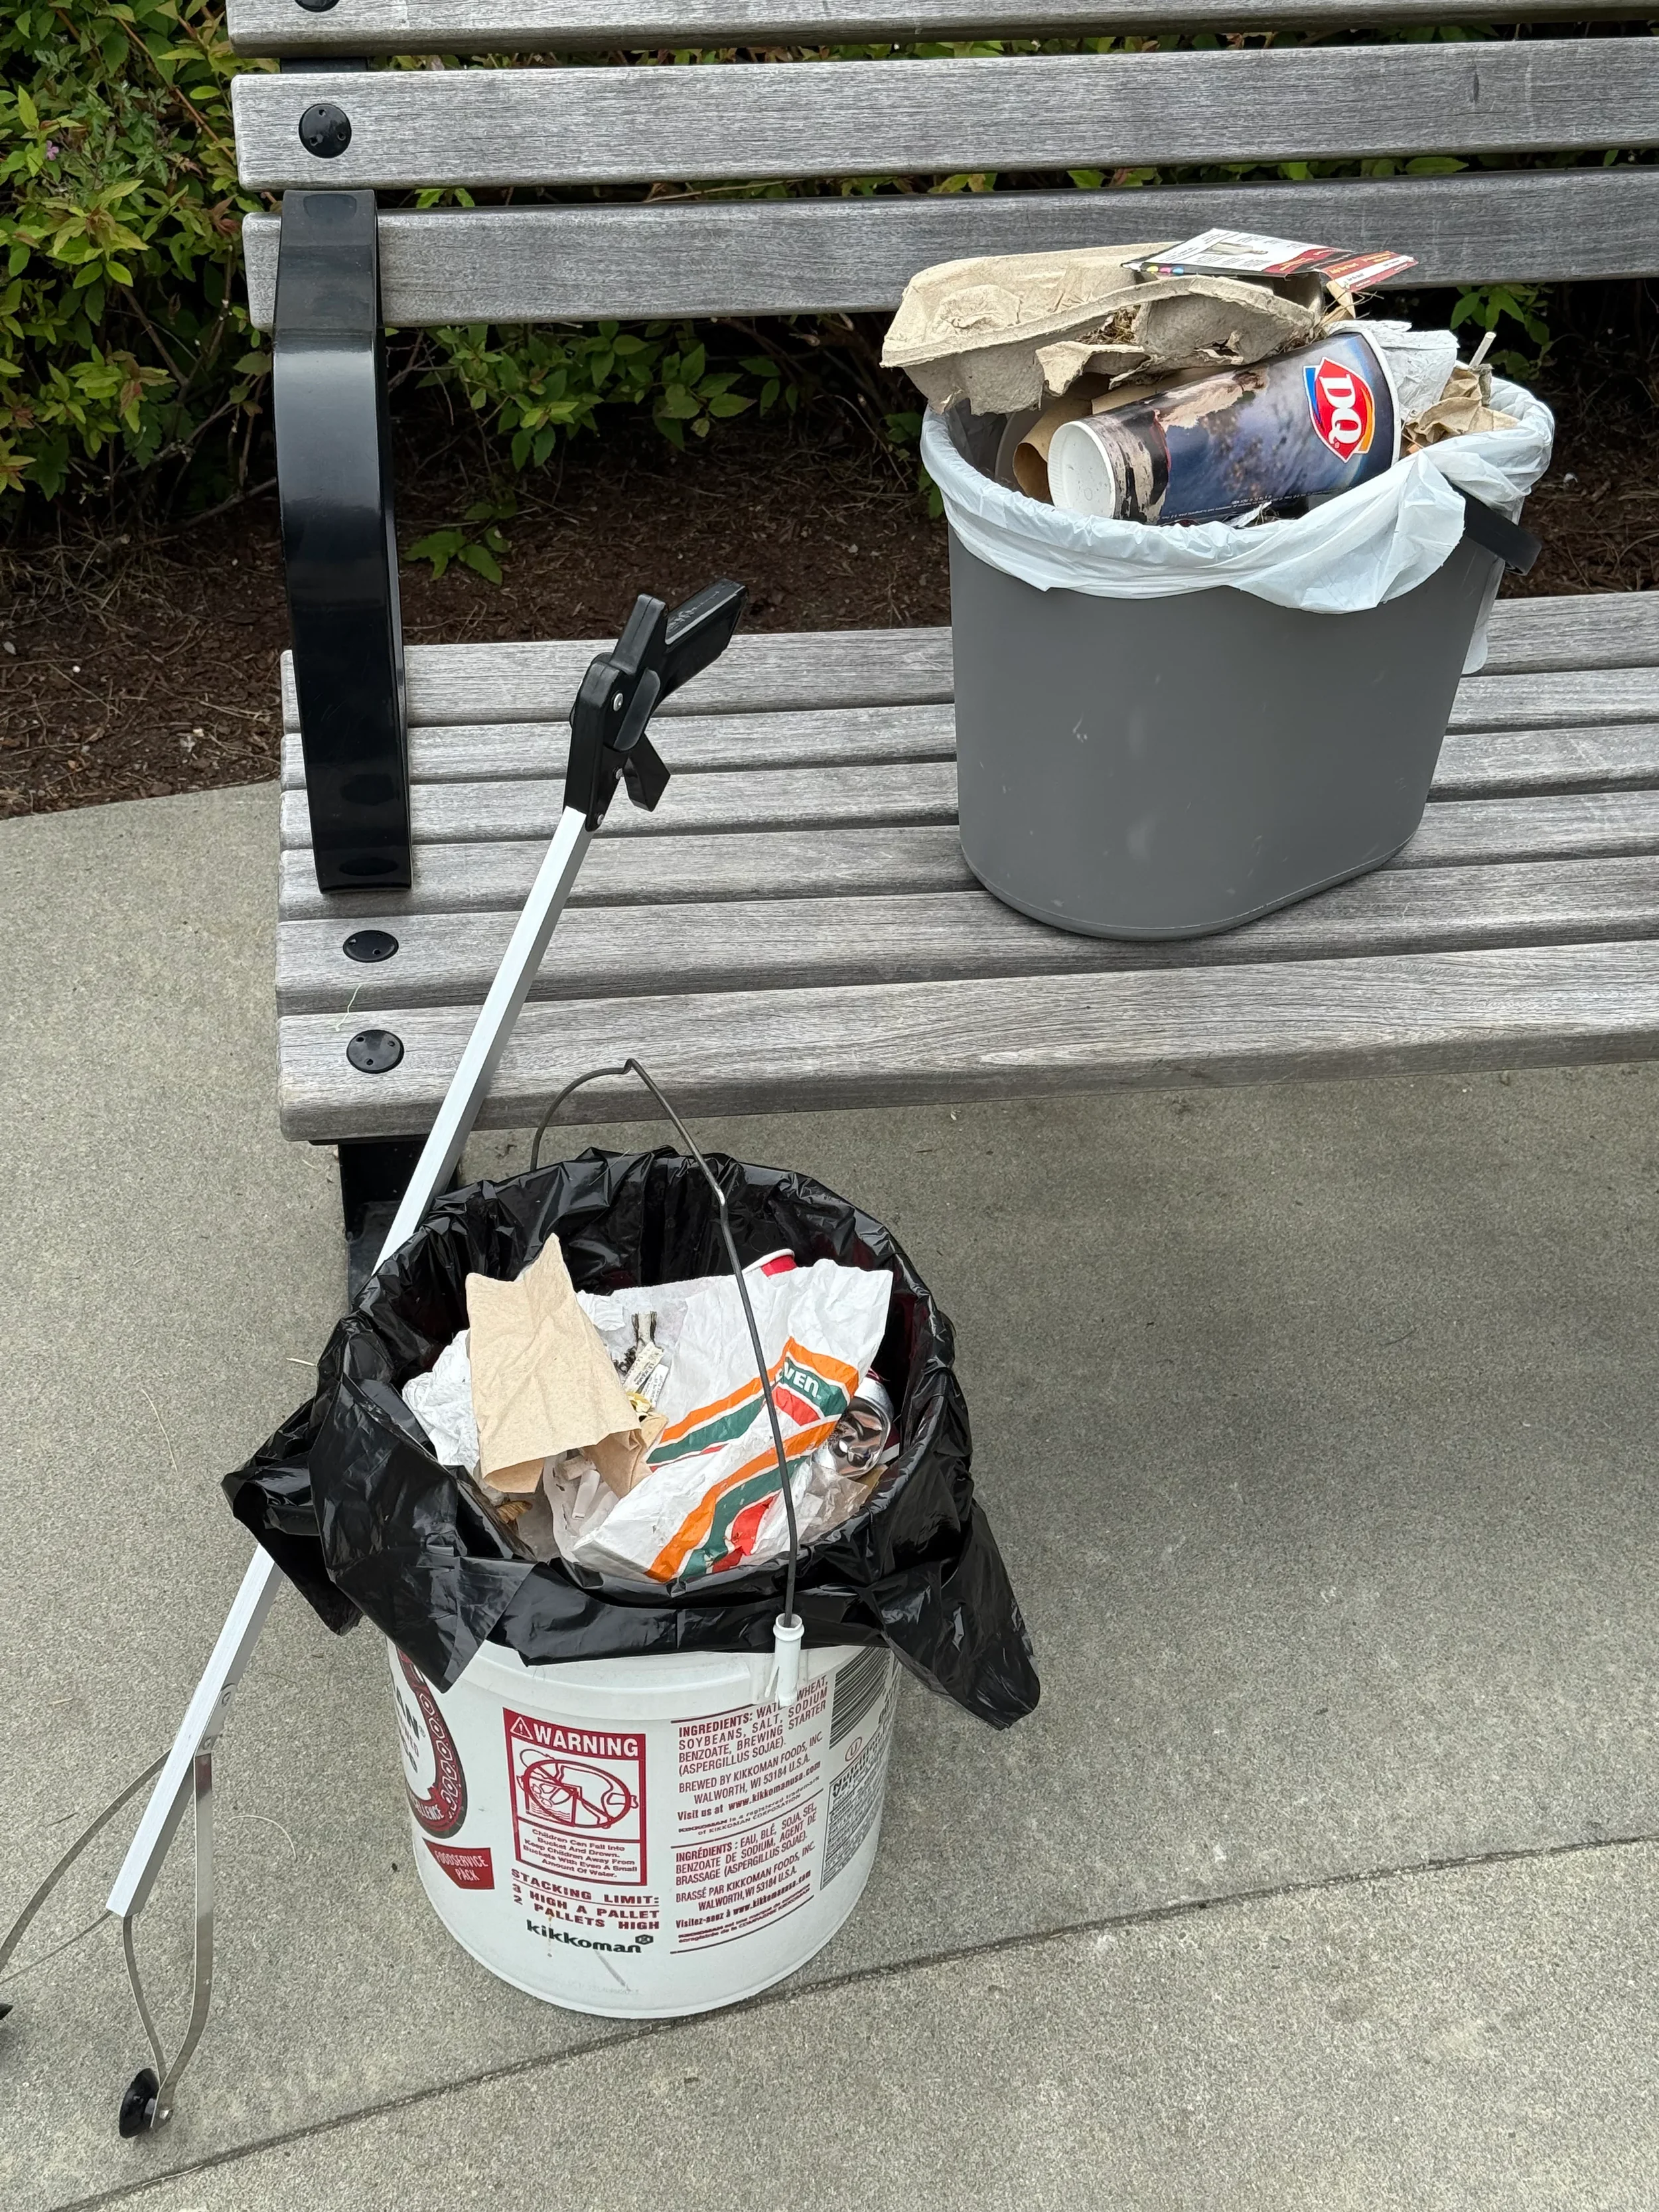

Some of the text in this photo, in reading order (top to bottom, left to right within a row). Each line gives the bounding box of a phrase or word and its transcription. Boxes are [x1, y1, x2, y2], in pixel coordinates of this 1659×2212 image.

[1319, 374, 1362, 444] DQ
[679, 1674, 828, 1737] INGREDIENTS: WAT WHEAT,
[679, 1687, 828, 1750] SOYBEANS, SALT, SODIUM
[534, 1724, 638, 1757] WARNING
[679, 1700, 826, 1763] BENZOATE, BREWING STARTER
[679, 1736, 786, 1777] (ASPERGILLUS SOJAE).
[679, 1777, 717, 1793] BREWED
[719, 1774, 731, 1786] BY
[733, 1756, 779, 1782] KIKKOMAN
[780, 1741, 808, 1764] FOODS,
[677, 1761, 821, 1821] Visit us at www.kikkomanusa.com
[693, 1782, 748, 1805] WALWORTH,
[750, 1777, 761, 1790] WI
[763, 1765, 786, 1785] 53184
[786, 1775, 820, 1799] trademark
[410, 1792, 445, 1820] CELLENCE
[709, 1817, 751, 1834] KIKKOMAN
[753, 1793, 801, 1820] CORPORATION
[523, 1844, 557, 1860] Buckets
[558, 1856, 577, 1866] With
[524, 1838, 545, 1851] Keep
[547, 1846, 583, 1860] Children
[585, 1856, 609, 1865] Away
[532, 1829, 568, 1844] Children
[570, 1839, 587, 1848] Can
[538, 1837, 566, 1850] Bucket
[569, 1846, 587, 1854] And
[676, 1812, 817, 1874] BENZOATE DE SODIUM, AGENT DE
[676, 1842, 733, 1862] INGRÉDIENTS
[740, 1833, 758, 1848] EAU,
[434, 1850, 490, 1867] FOODSERVICE
[455, 1868, 480, 1882] PACK
[541, 1858, 575, 1872] Amount
[676, 1868, 721, 1886] BRASSAGE
[724, 1848, 780, 1877] (ASPERGILLUS
[511, 1868, 660, 1904] STACKING LIMIT:
[676, 1887, 707, 1903] BRASSÉ
[709, 1885, 724, 1897] PAR
[727, 1867, 772, 1891] KIKKOMAN
[773, 1852, 800, 1873] FOODS,
[698, 1890, 745, 1911] WALWORTH,
[745, 1887, 755, 1897] WI
[756, 1876, 776, 1893] 53184
[512, 1883, 660, 1919] 3 HIGH A PALLET
[514, 1895, 660, 1930] 2 PALLETS HIGH
[526, 1919, 642, 1953] kikkoman
